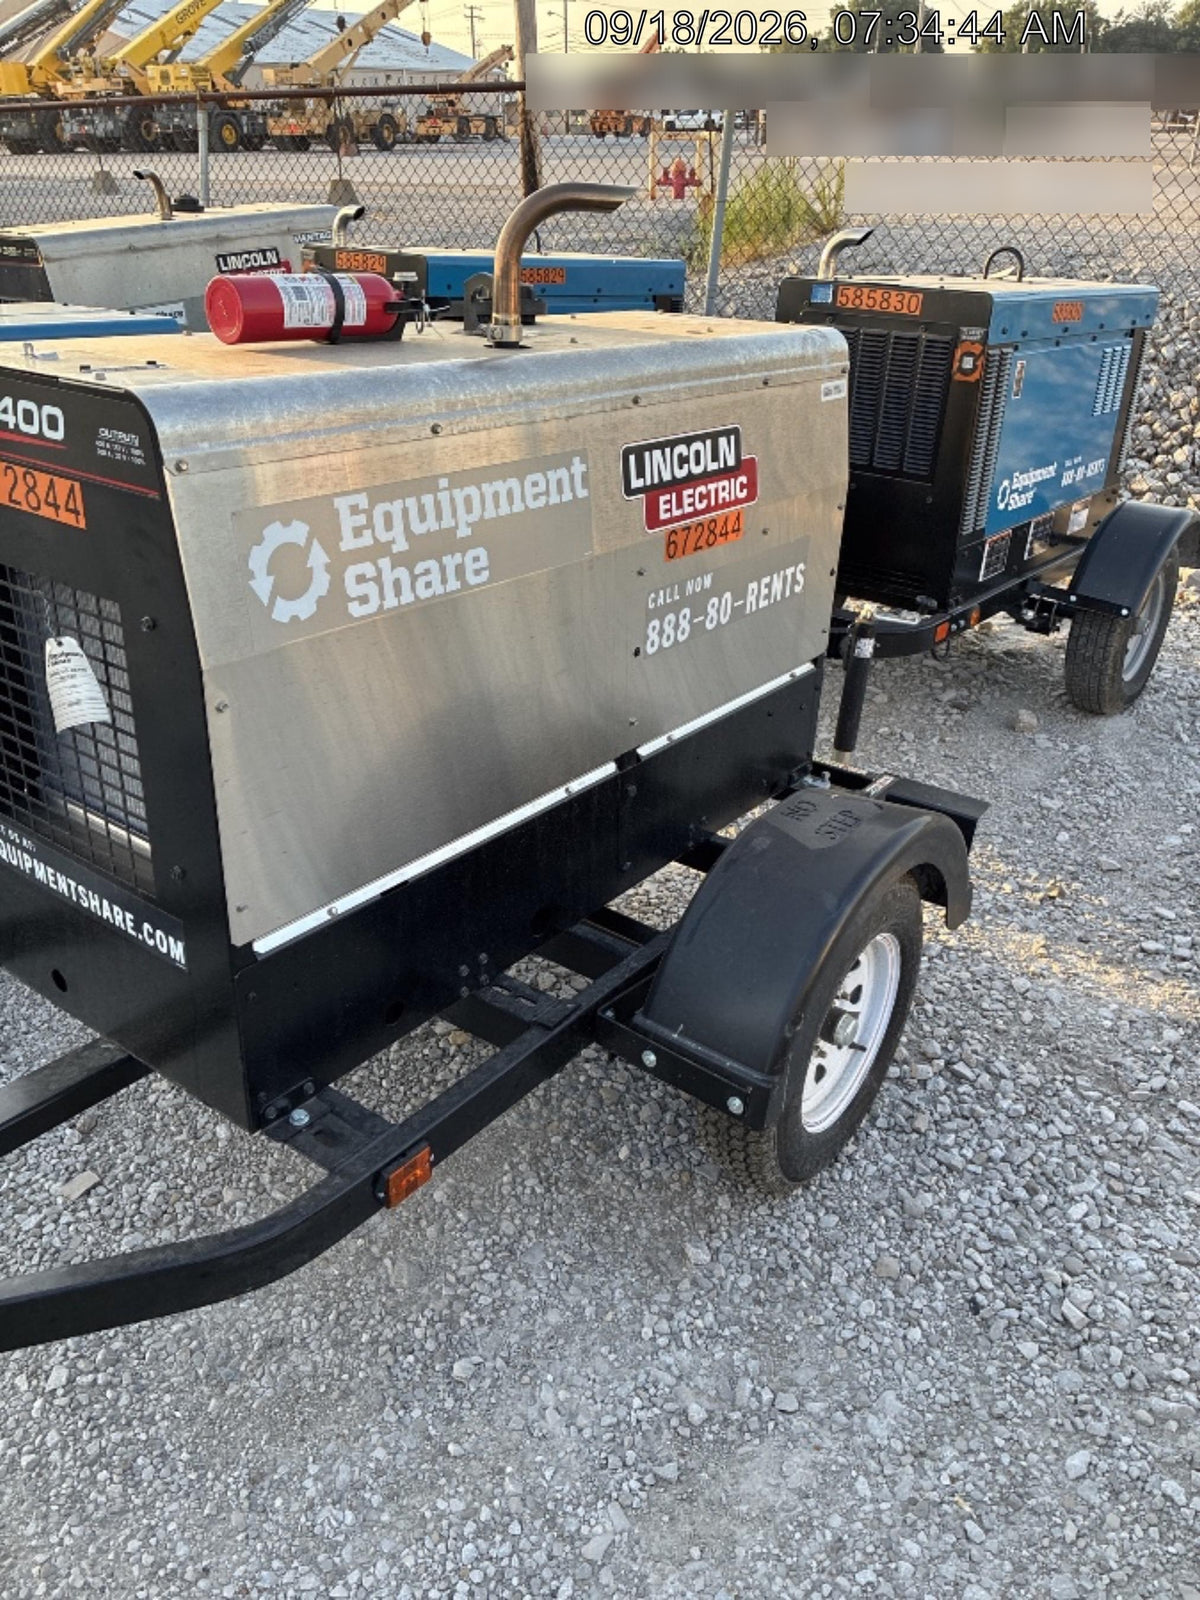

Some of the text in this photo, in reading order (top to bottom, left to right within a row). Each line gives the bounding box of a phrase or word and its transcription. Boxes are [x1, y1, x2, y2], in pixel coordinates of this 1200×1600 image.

[219, 250, 278, 271] LINCOLN
[293, 231, 332, 243] VANTAG
[839, 287, 920, 313] 585830
[0, 396, 64, 441] 400
[629, 435, 736, 489] LINCOLN
[4, 465, 81, 524] 2844
[334, 456, 589, 553] Equipment
[659, 475, 748, 520] ELECTRIC
[667, 512, 742, 560] 672844
[344, 547, 489, 618] Share
[648, 572, 714, 610] CALL NOW
[646, 563, 806, 655] 888-80-RENTS
[0, 838, 187, 966] QUIPMENTSHARE.COM
